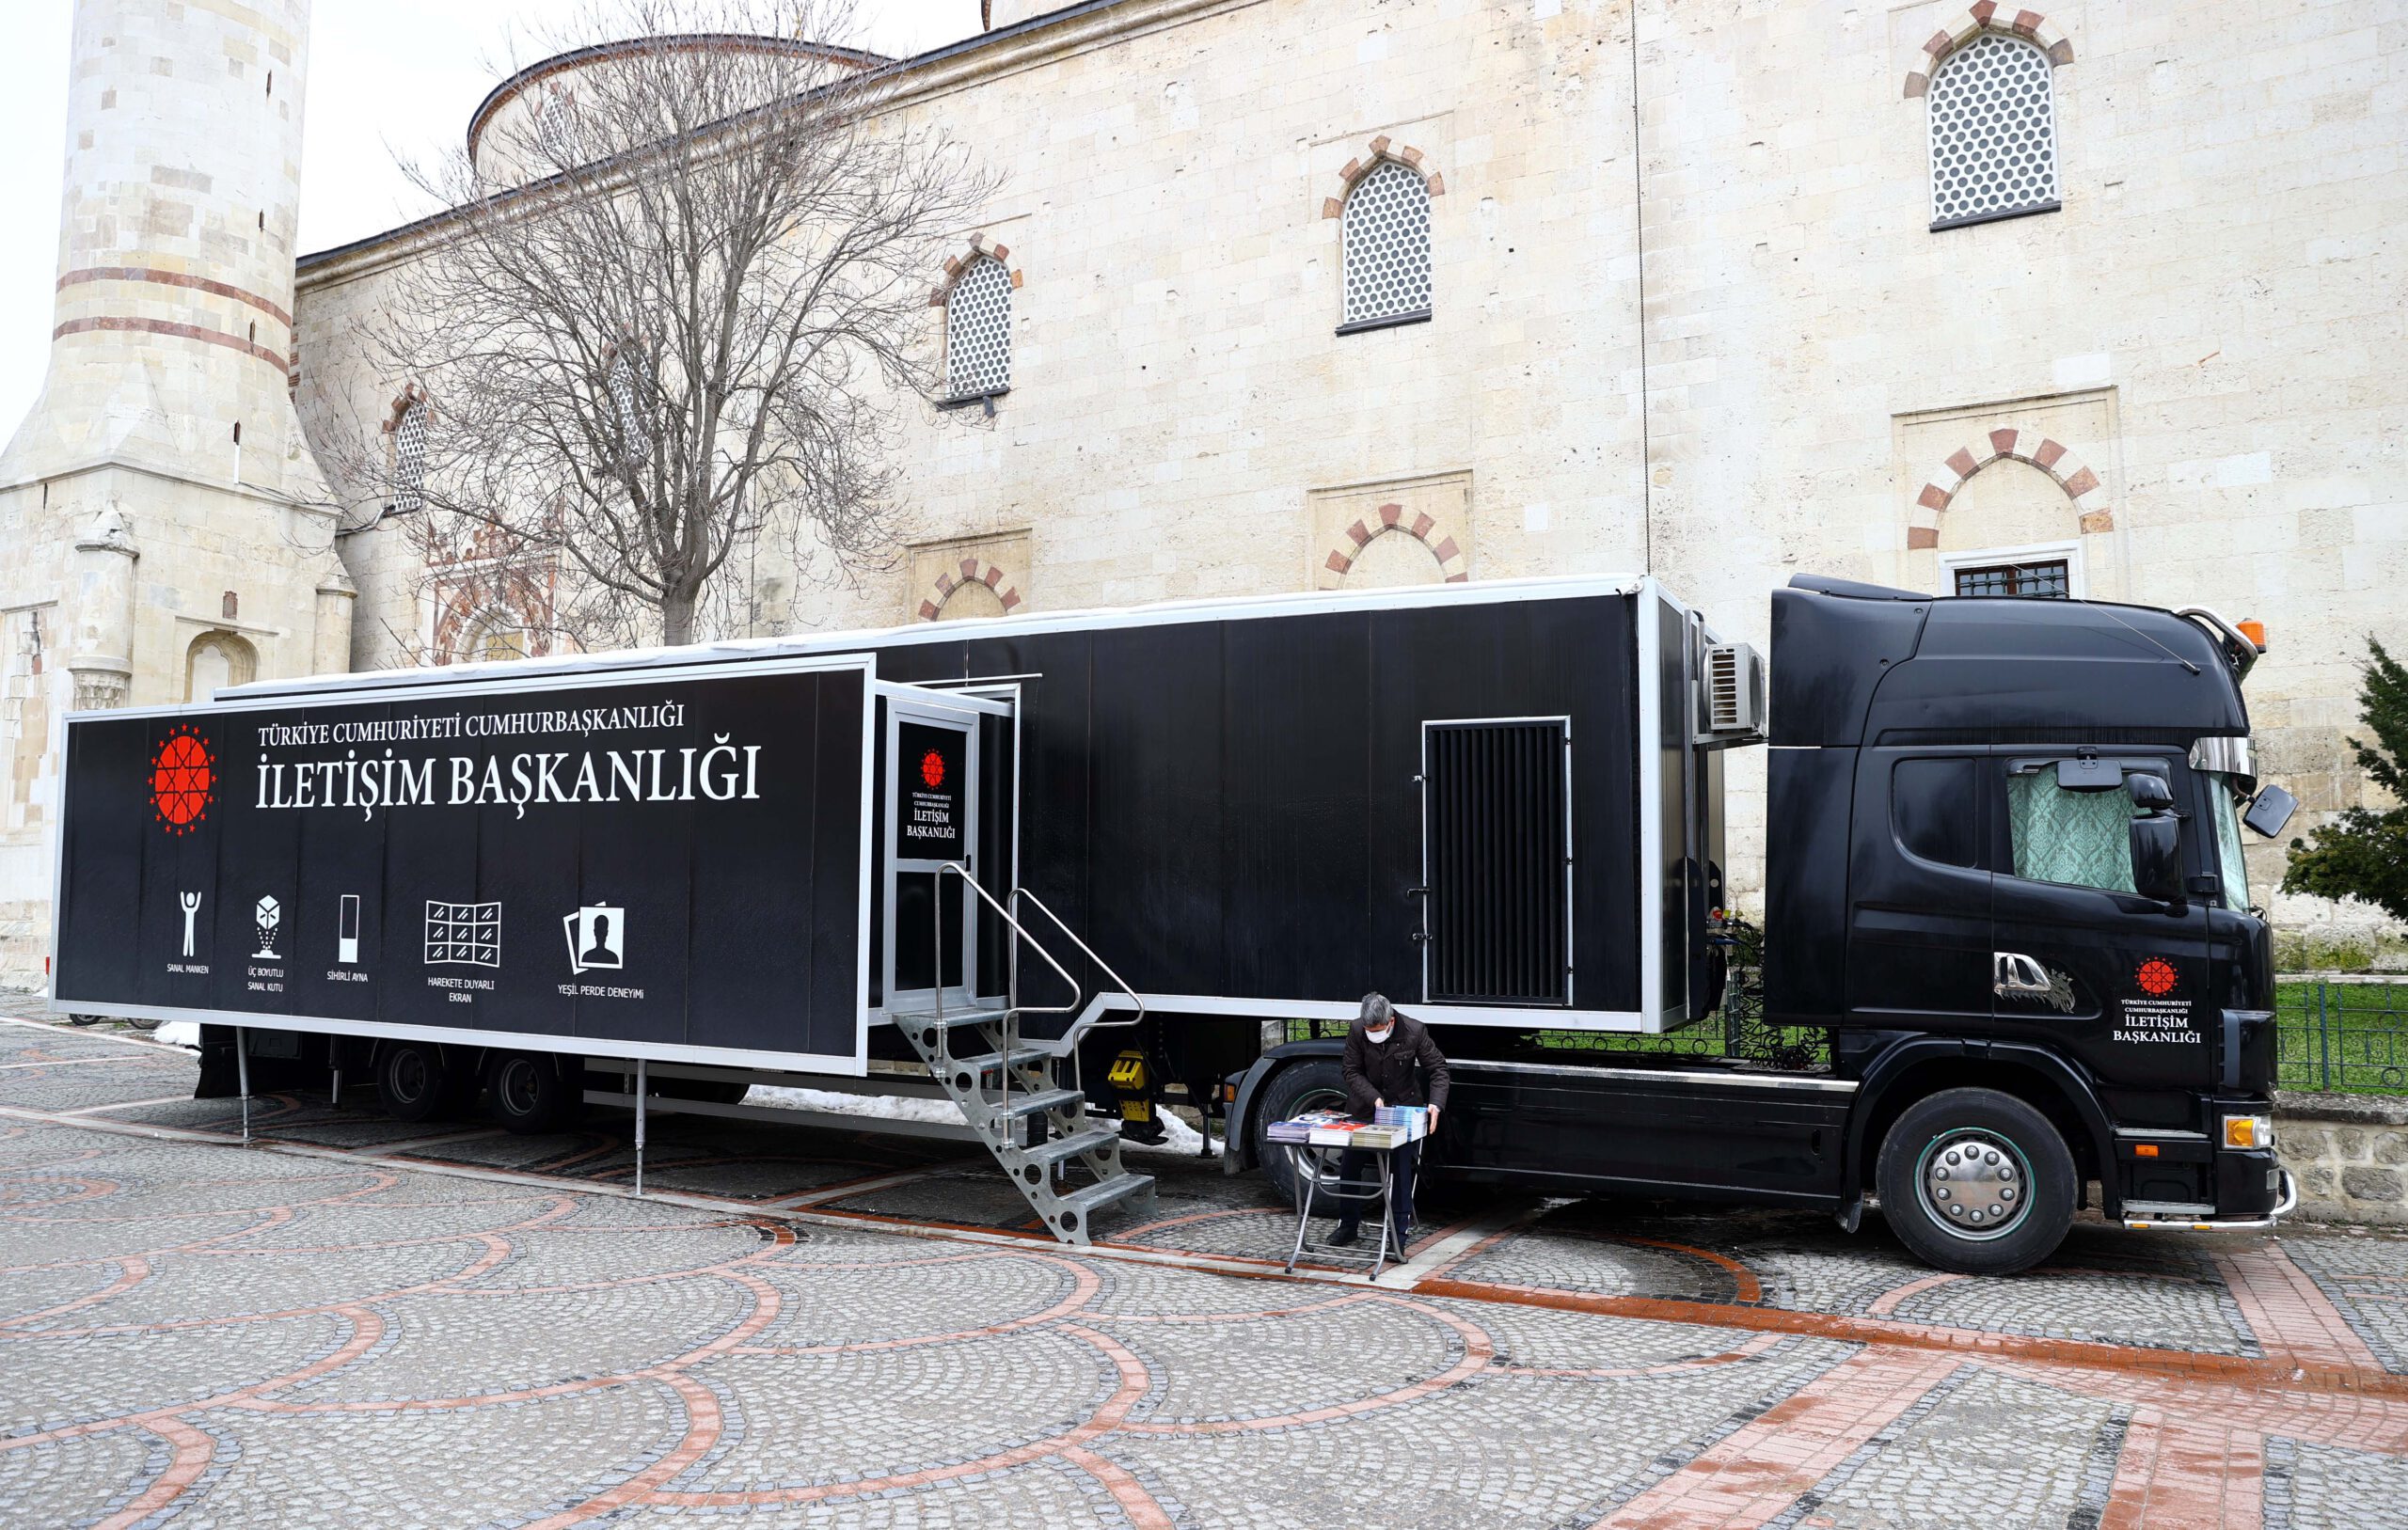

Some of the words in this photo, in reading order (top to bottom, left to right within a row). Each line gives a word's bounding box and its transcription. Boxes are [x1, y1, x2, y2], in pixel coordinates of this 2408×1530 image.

[259, 720, 330, 747] TÜRKİYE
[332, 712, 461, 744] CUMHURİYETİ
[465, 700, 685, 738] CUMHURBAŞKANLIĞI
[255, 748, 436, 822] İLETİŞİM
[447, 732, 762, 820] BAŞKANLIĞI
[914, 808, 949, 825] İLETİŞİM
[907, 825, 956, 840] BAŞKANLIĞI
[166, 963, 184, 973] SANAL
[186, 964, 210, 974] MANKEN
[247, 966, 257, 978] ÜÇ
[258, 967, 284, 978] BOYUTLU
[352, 972, 369, 983] AYNA
[427, 977, 463, 988] HAREKETE
[464, 979, 495, 990] DUYARLI
[247, 981, 266, 991] SANAL
[267, 983, 284, 993] KUTU
[557, 984, 579, 997] YEŞİL
[580, 986, 606, 997] PERDE
[449, 992, 472, 1003] EKRAN
[2125, 1014, 2189, 1031] İLETİŞİM
[2113, 1030, 2202, 1045] BAŞKANLIĞI
